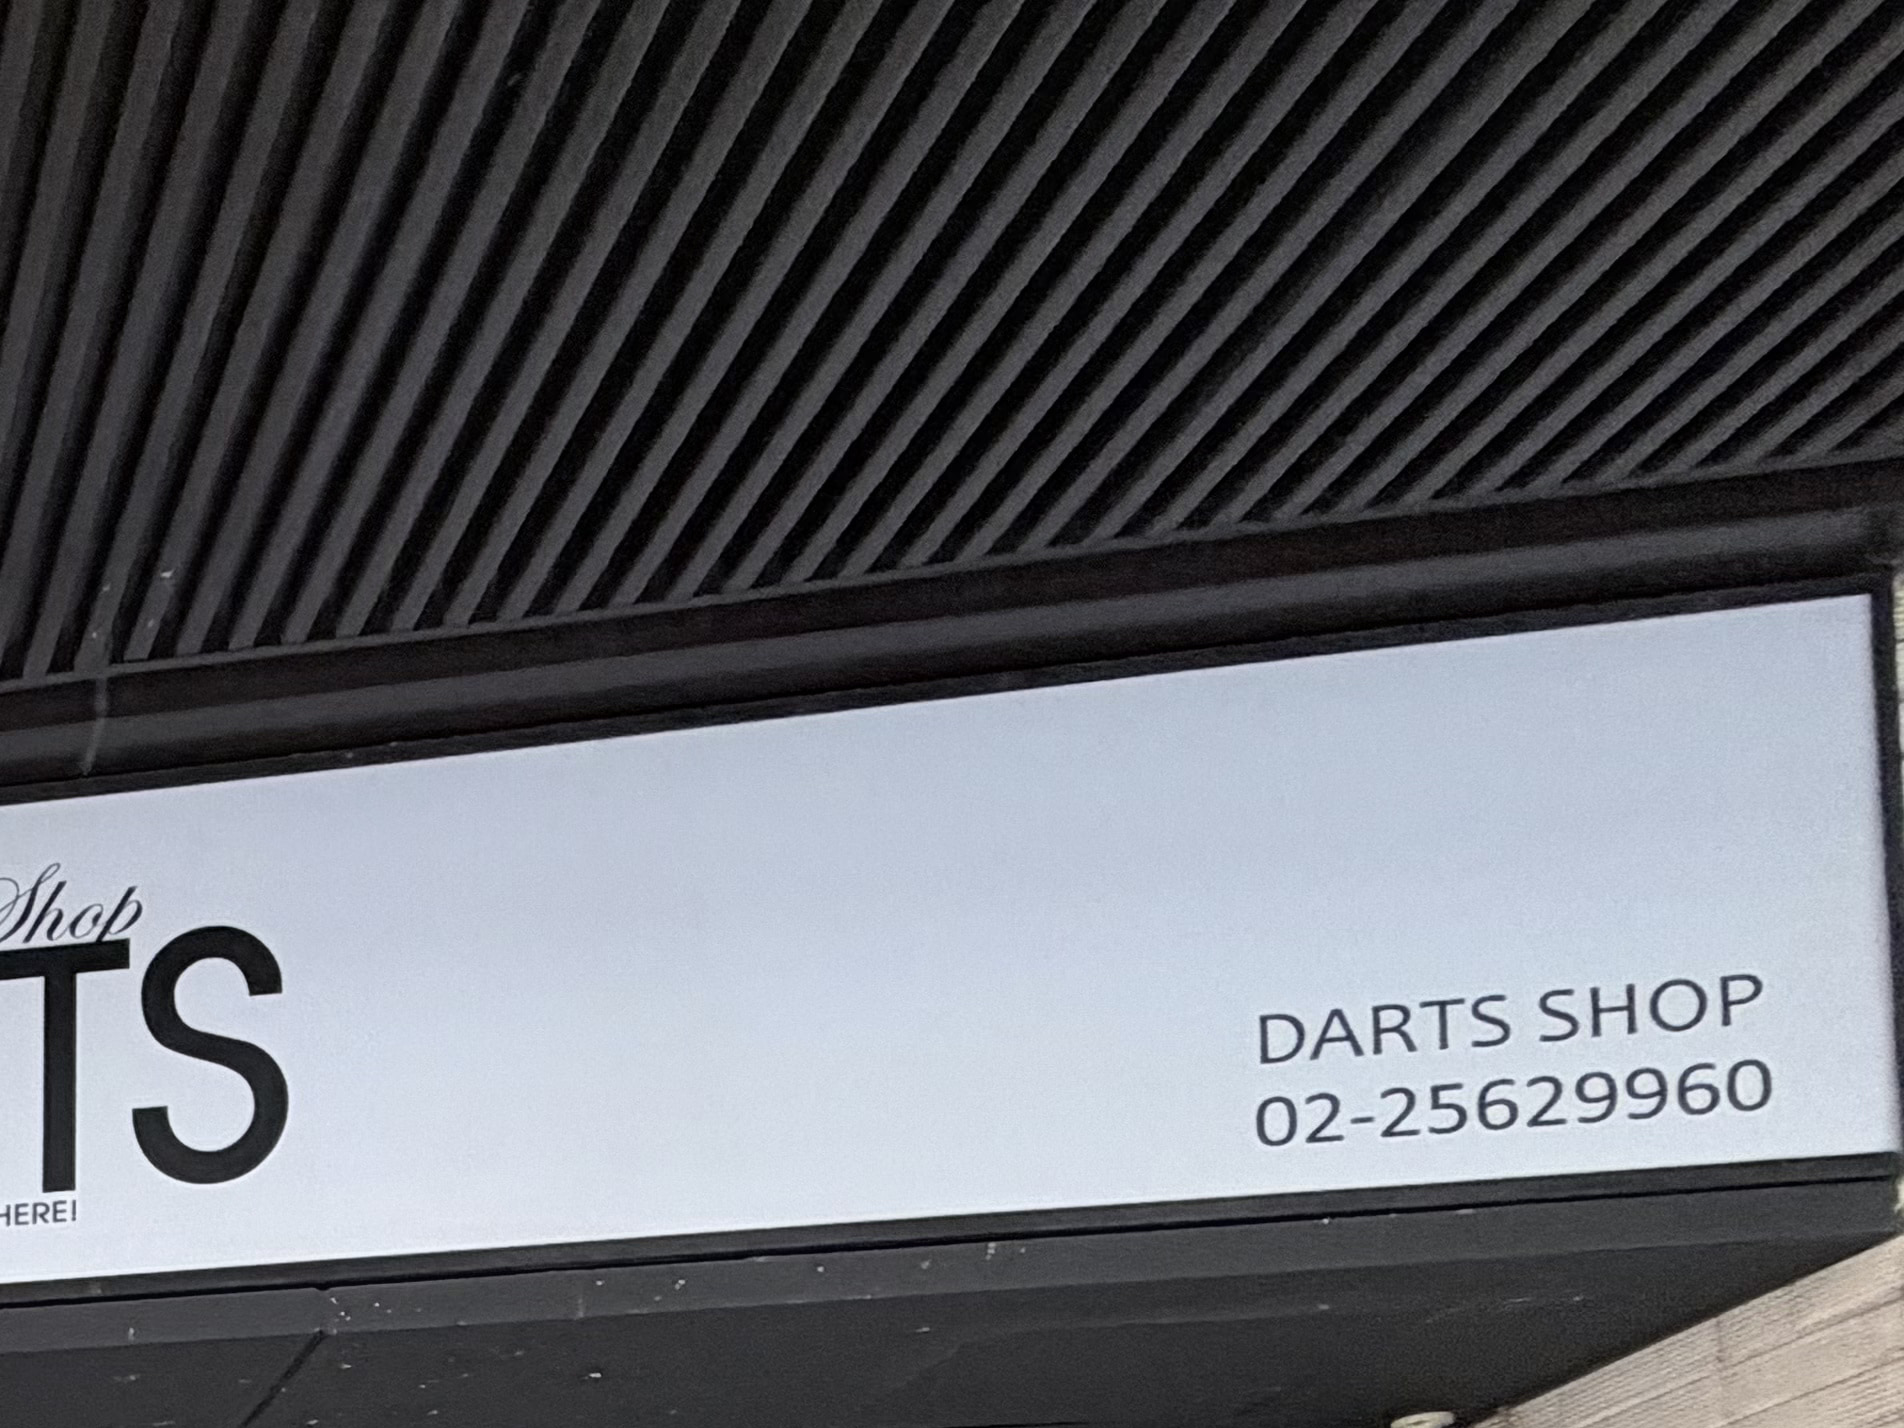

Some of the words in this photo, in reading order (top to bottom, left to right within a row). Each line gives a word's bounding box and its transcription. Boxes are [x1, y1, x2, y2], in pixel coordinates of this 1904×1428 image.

[1258, 993, 1512, 1065] DARTS
[1537, 973, 1764, 1043] SHOP
[1255, 1058, 1773, 1147] 02-25629960
